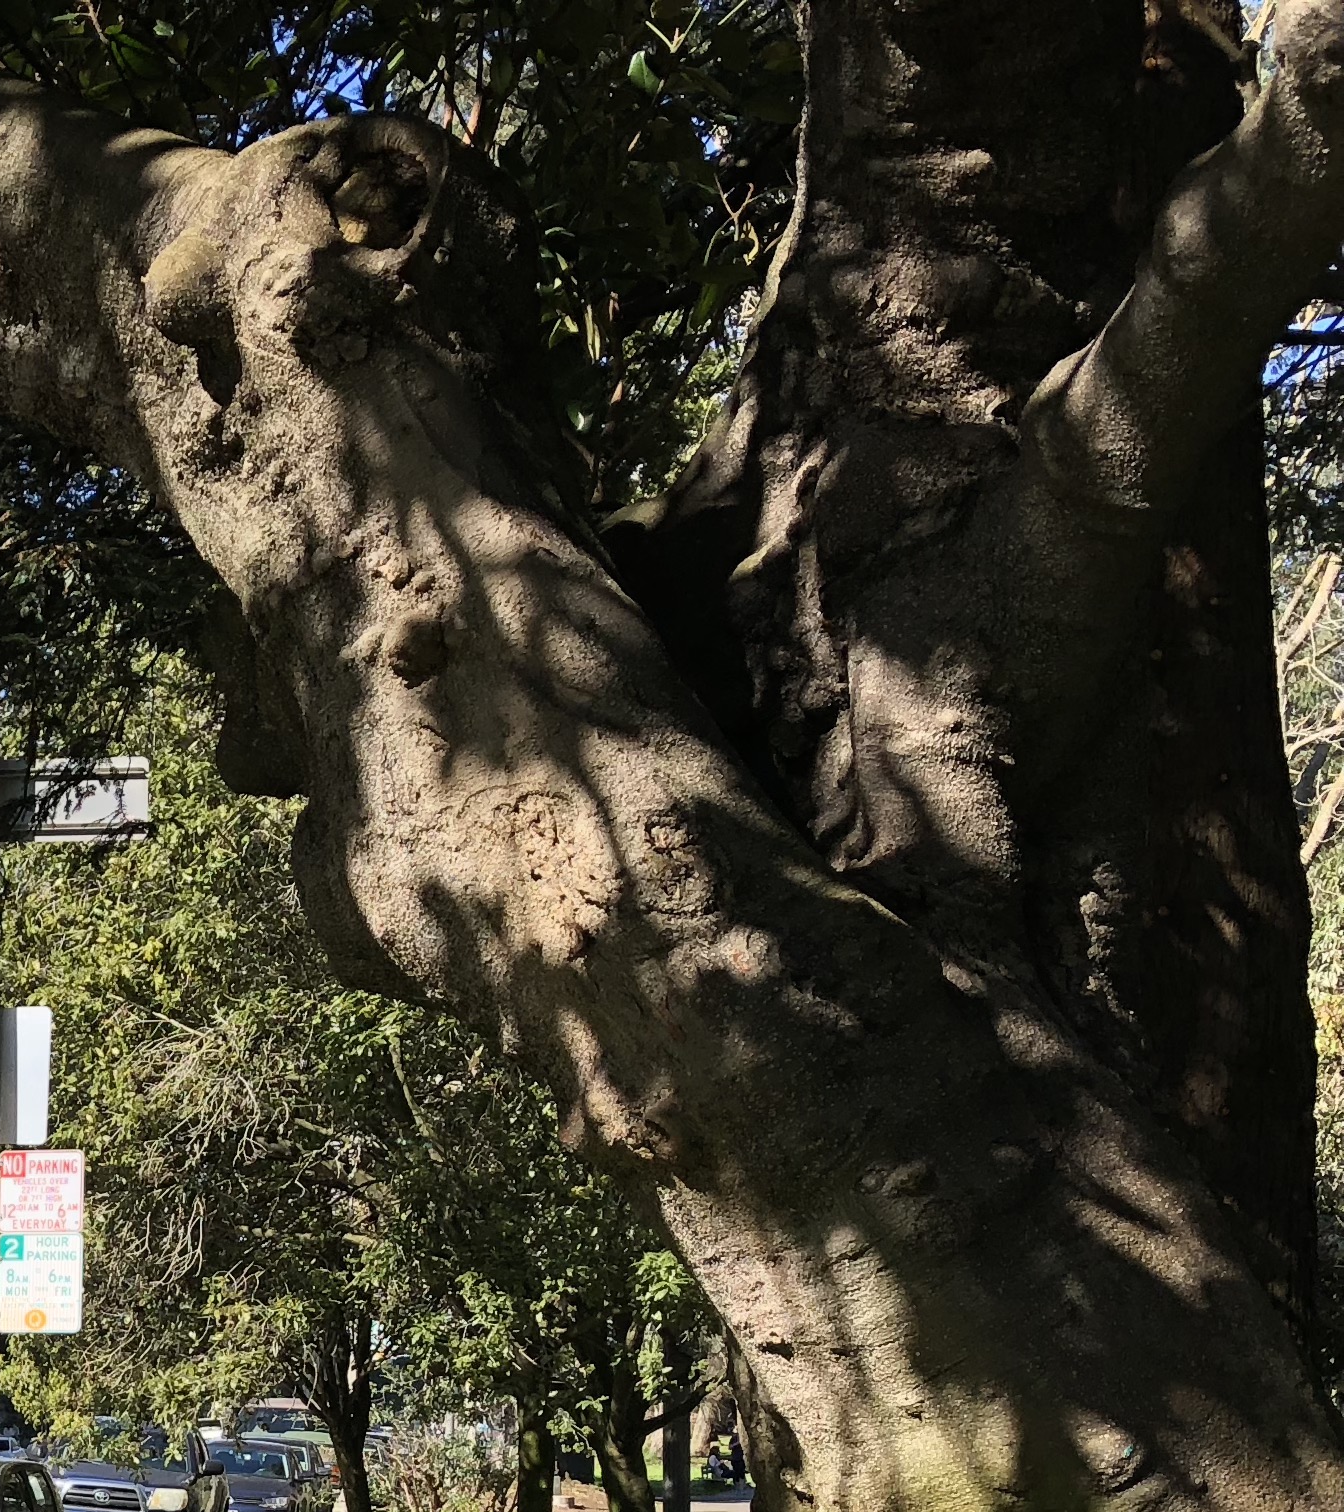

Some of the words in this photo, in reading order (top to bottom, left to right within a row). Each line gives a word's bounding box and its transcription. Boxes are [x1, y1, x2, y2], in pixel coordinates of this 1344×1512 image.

[2, 1155, 23, 1175] NO
[29, 1159, 78, 1174] PARKING
[12, 1219, 67, 1230] EVERYDAY
[4, 1238, 19, 1259] 2
[36, 1237, 69, 1247] HOUR
[26, 1251, 77, 1260] PARKING
[5, 1286, 28, 1297] MON
[54, 1286, 72, 1297] FRI
